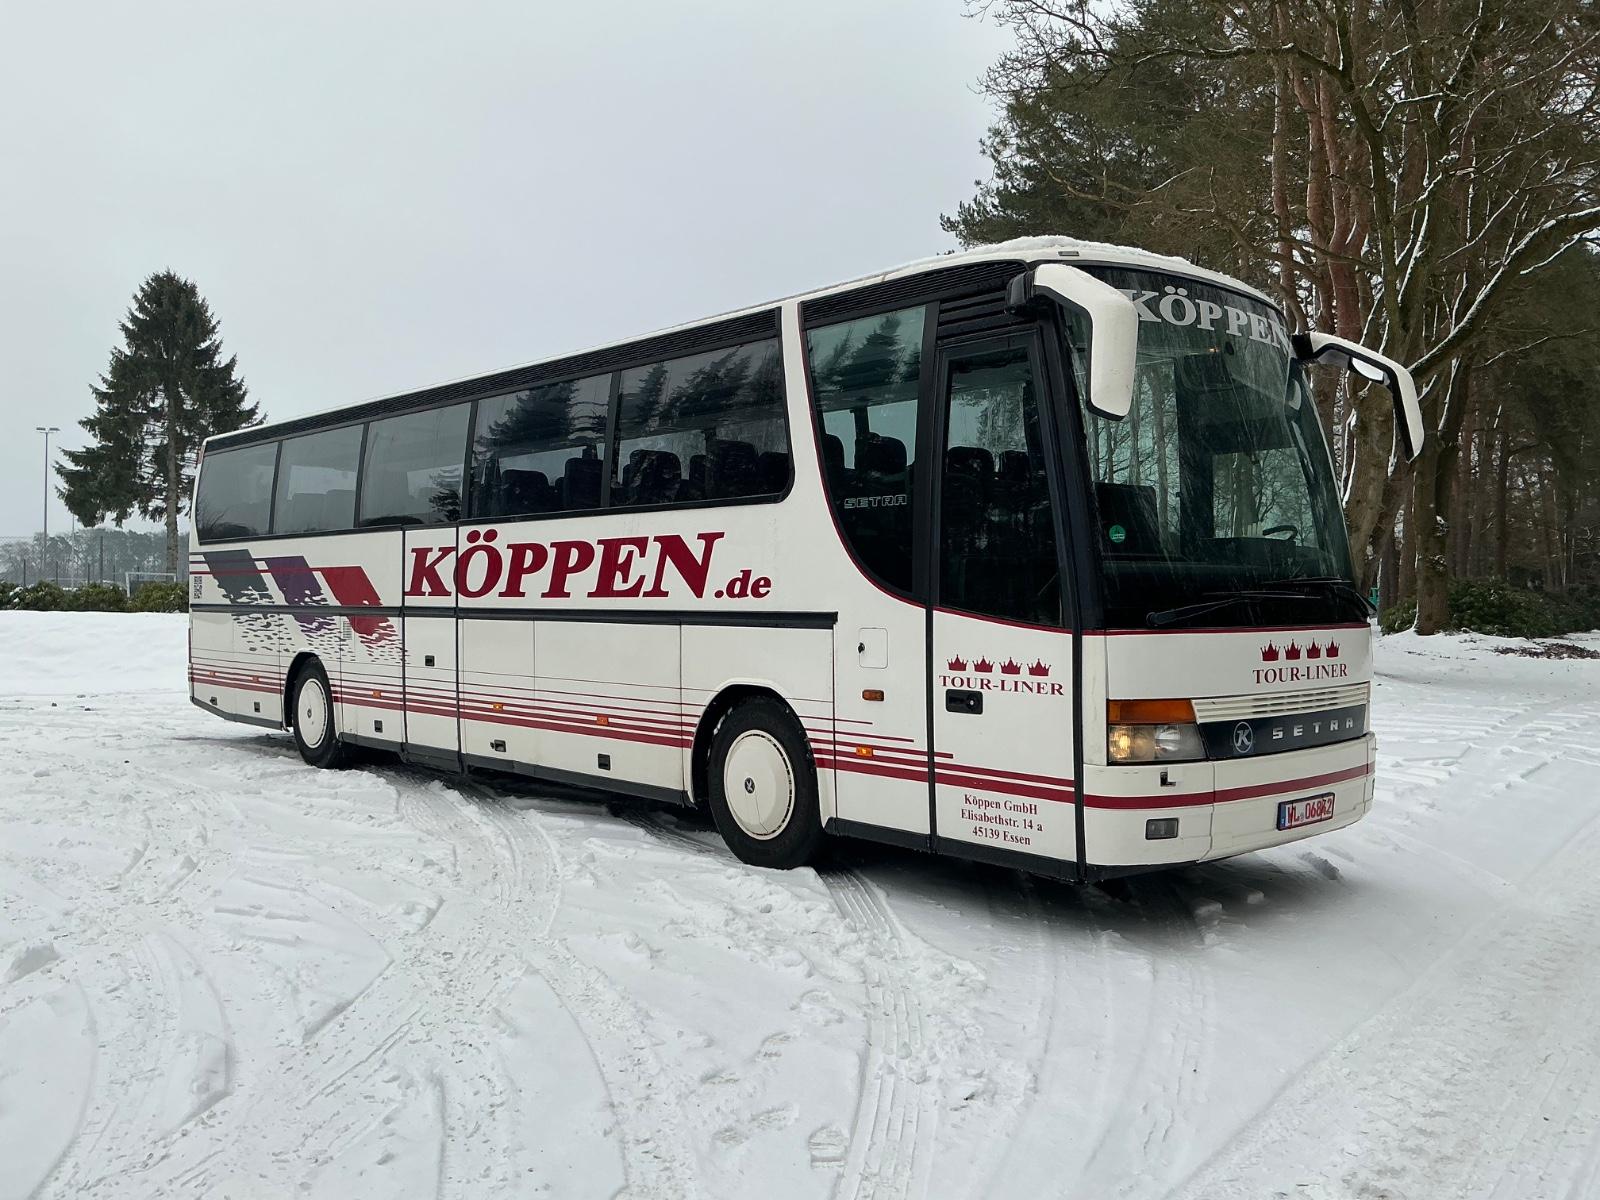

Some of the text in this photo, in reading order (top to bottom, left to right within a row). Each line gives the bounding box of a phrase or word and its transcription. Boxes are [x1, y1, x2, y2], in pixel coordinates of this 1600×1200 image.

[1117, 285, 1294, 357] KÖPPEN
[844, 494, 907, 509] SETRA
[1252, 663, 1348, 684] TOUR-LINER
[939, 675, 1064, 696] TOUR-LINER
[1272, 717, 1354, 740] SETRA
[964, 794, 1037, 815] Köppen GmbH
[961, 808, 1043, 831] Elisabethstr. 14 a
[972, 826, 1031, 845] 45139 Essen
